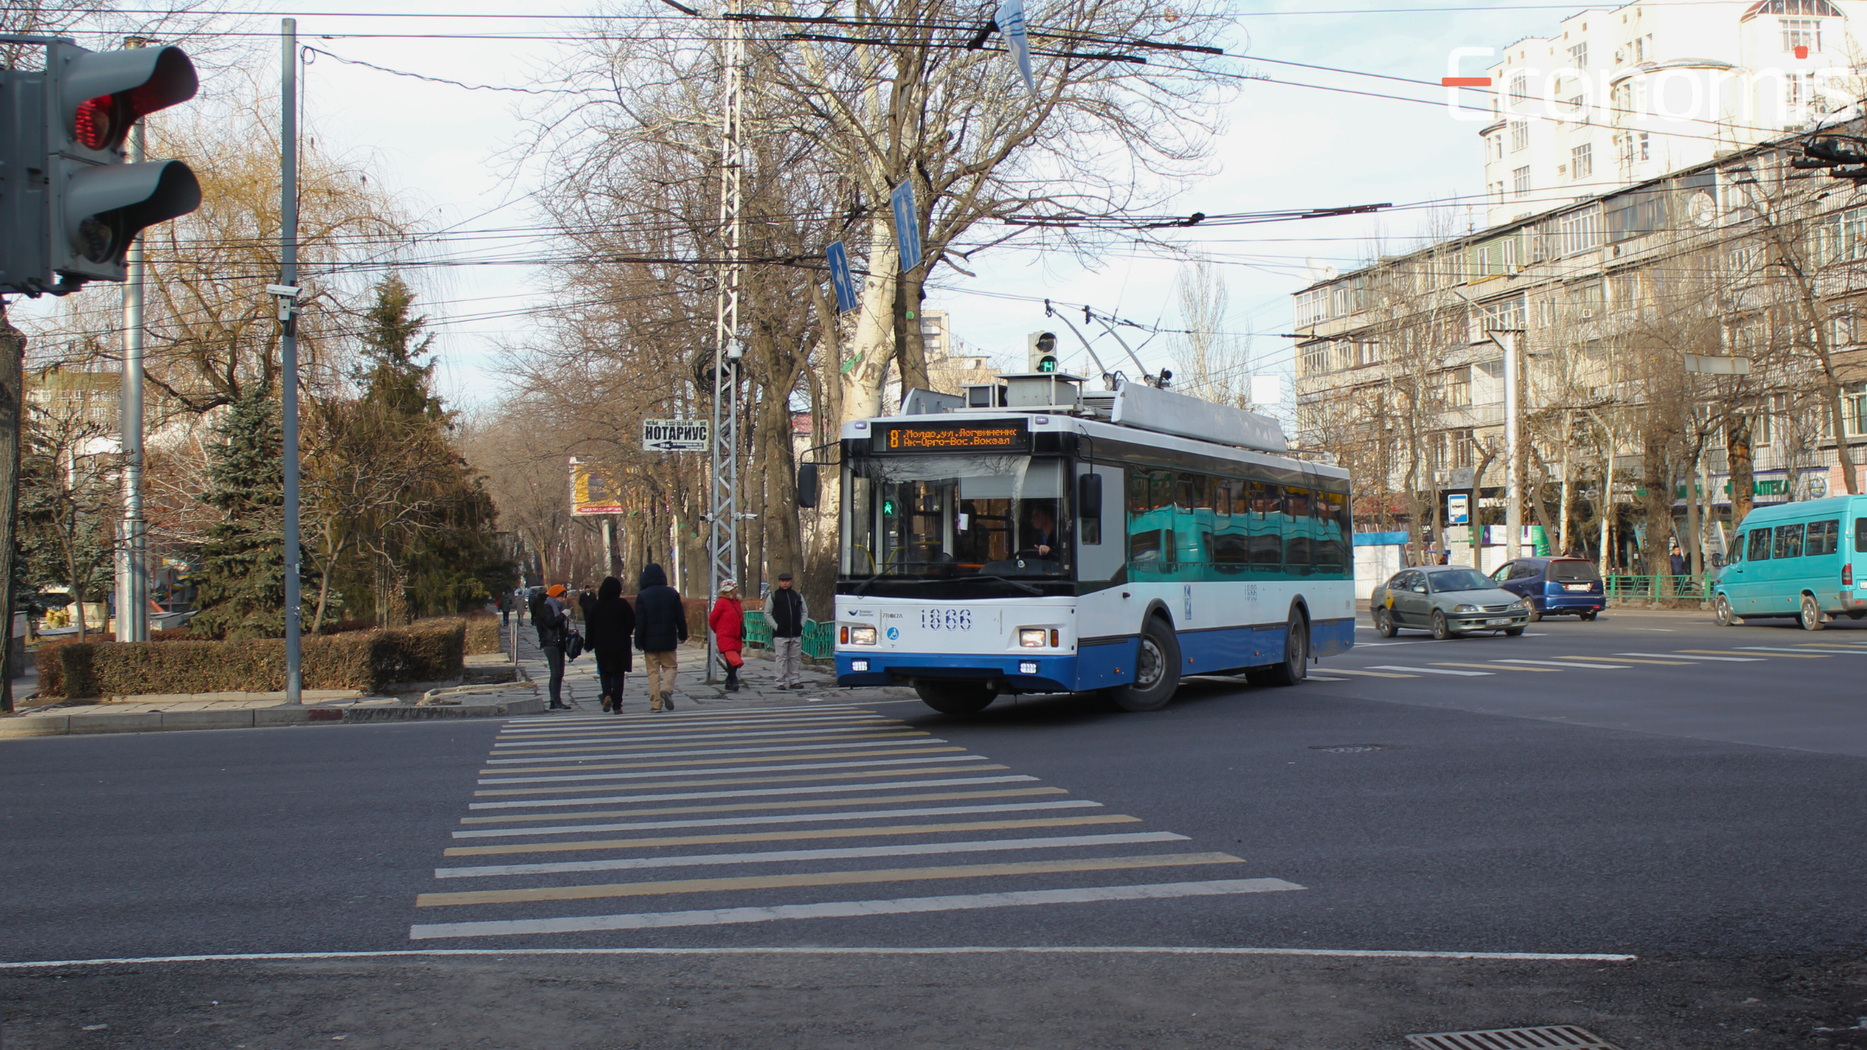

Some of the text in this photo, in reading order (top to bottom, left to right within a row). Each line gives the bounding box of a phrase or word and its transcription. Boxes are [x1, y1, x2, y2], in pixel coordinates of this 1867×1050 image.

[645, 426, 707, 440] НОТАРИУС
[890, 429, 899, 448] 8
[921, 608, 972, 630] 1866
